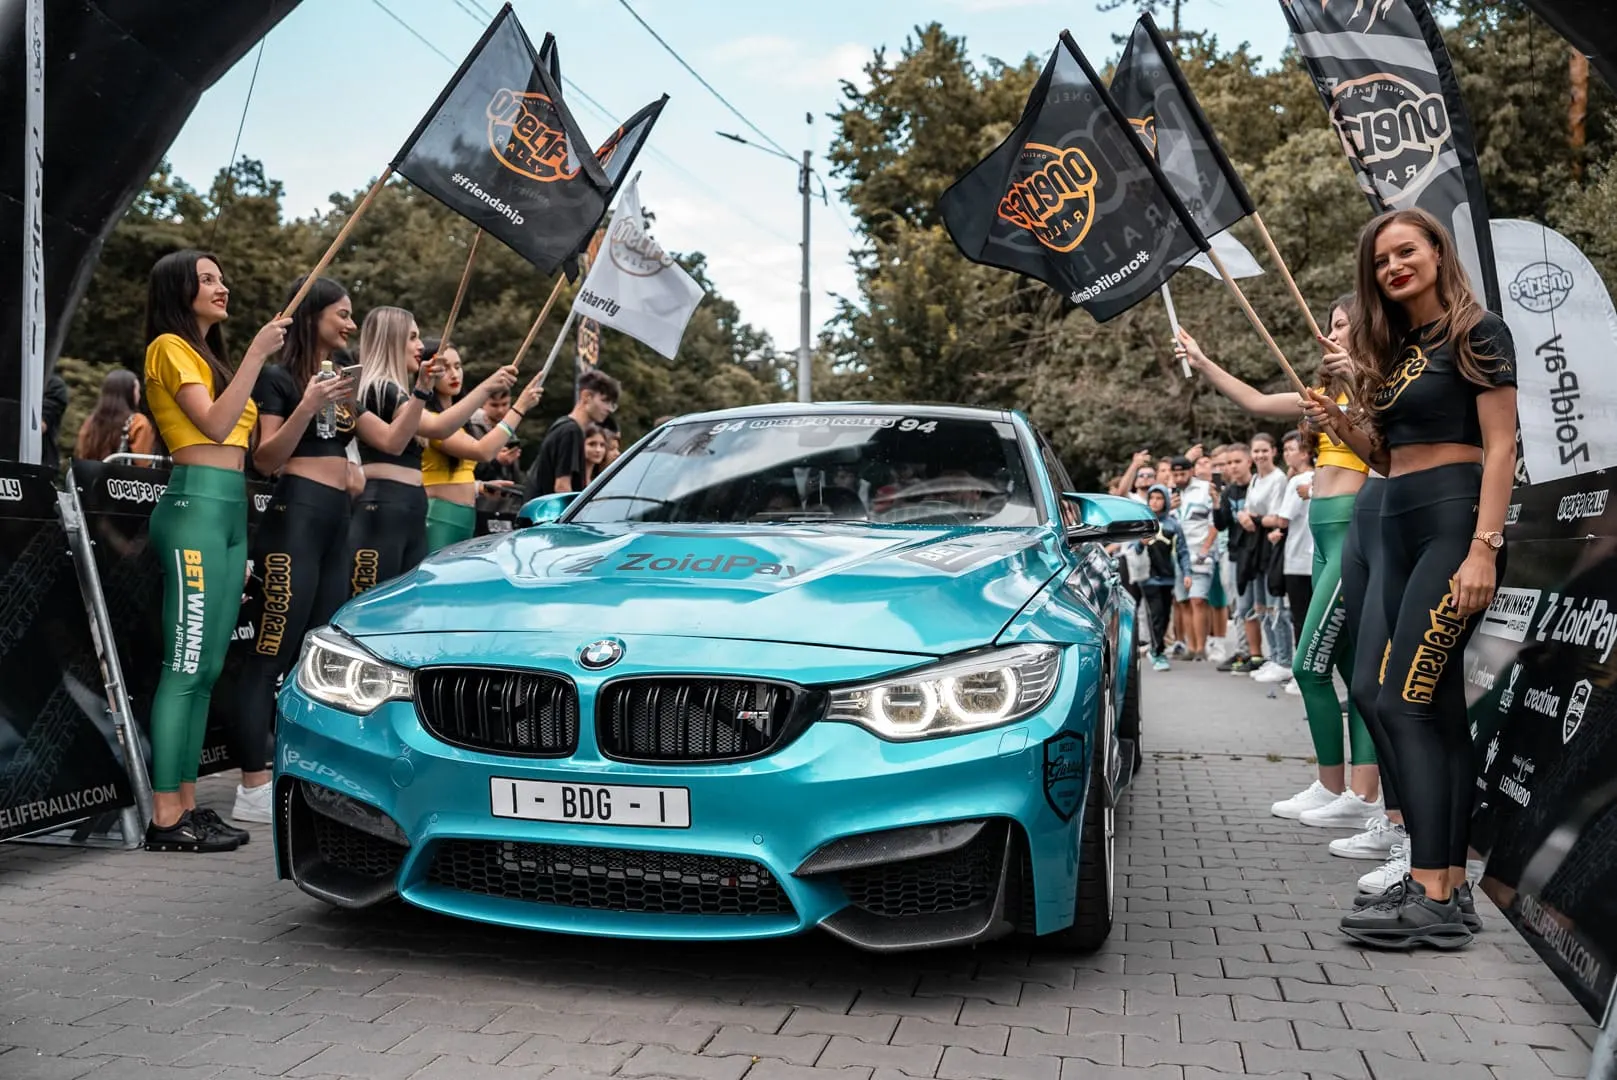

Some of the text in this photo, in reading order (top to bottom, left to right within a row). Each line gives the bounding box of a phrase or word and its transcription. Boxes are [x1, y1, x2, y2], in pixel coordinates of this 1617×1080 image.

[496, 134, 543, 174] RALLY
[451, 173, 525, 225] #friendship
[580, 288, 621, 317] #charity
[709, 420, 746, 435] 94
[898, 418, 938, 434] 94
[616, 553, 808, 580] ZoidPay
[182, 549, 205, 675] BET WINNER
[1551, 596, 1617, 664] ZoidPay
[172, 623, 184, 673] AFFILIATES
[1302, 629, 1321, 671] AFFILIATES
[1312, 606, 1346, 675] WINNER
[561, 786, 612, 820] BDG
[1499, 774, 1531, 807] LEONARDO
[1521, 894, 1602, 990] ONELIFERALLY.COM
